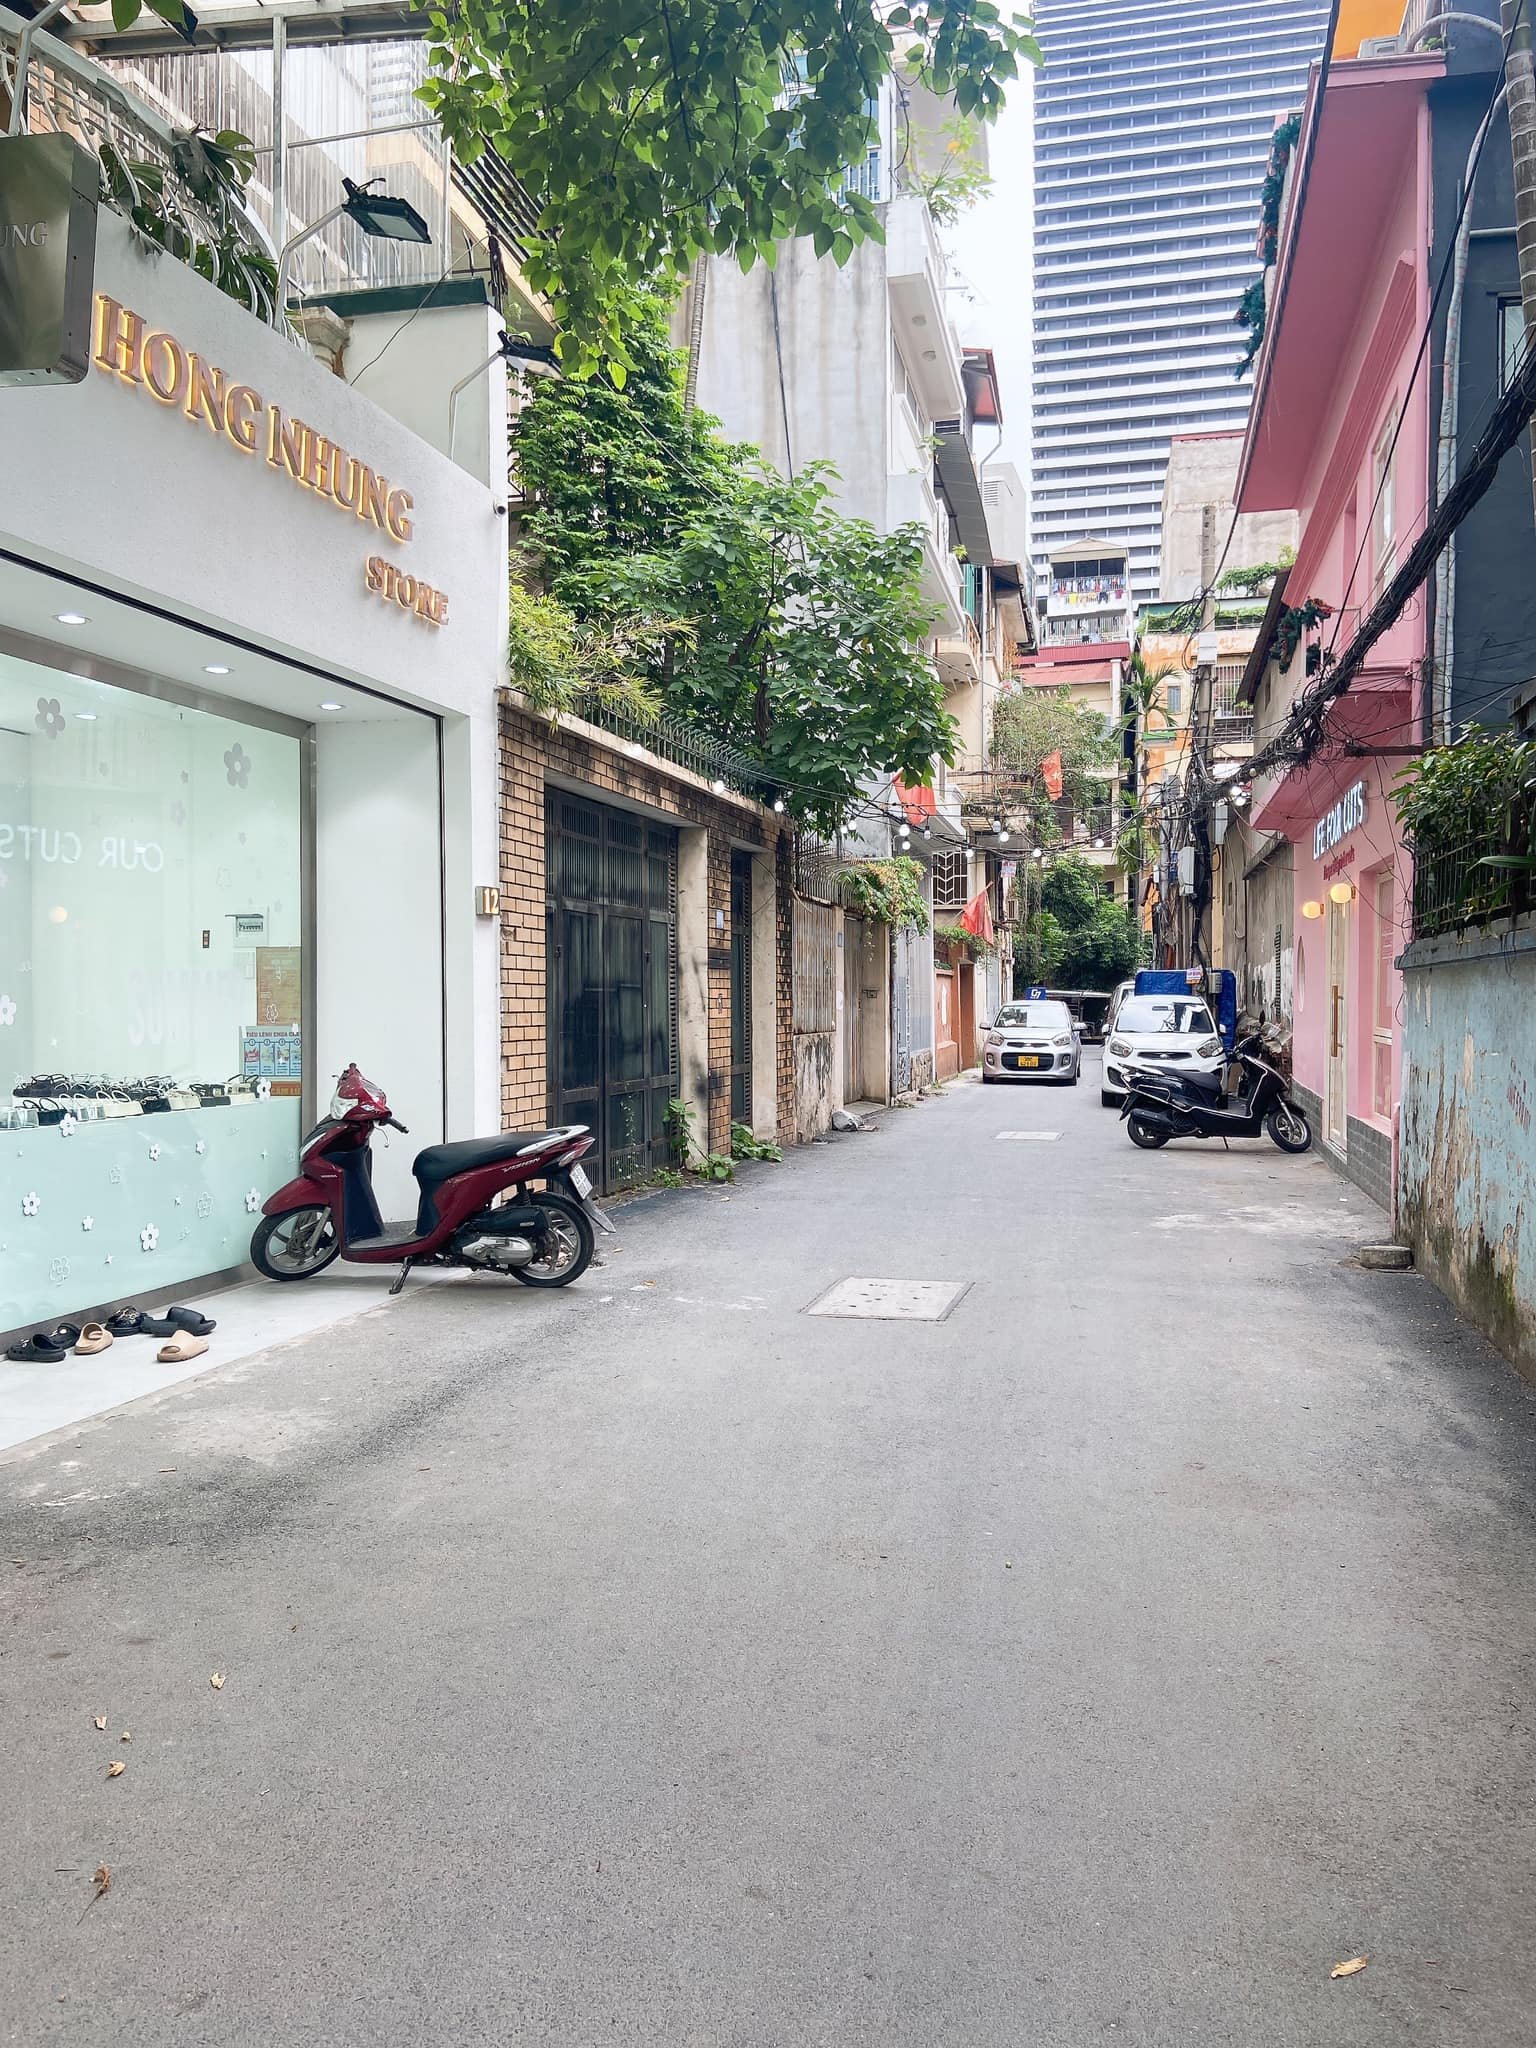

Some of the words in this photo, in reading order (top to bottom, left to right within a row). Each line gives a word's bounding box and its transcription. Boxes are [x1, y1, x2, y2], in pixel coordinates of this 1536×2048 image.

[95, 294, 263, 451] HONG
[267, 404, 415, 543] NHUNG
[365, 555, 450, 627] STORE
[1343, 780, 1364, 834] CUTS
[483, 887, 499, 914] 12
